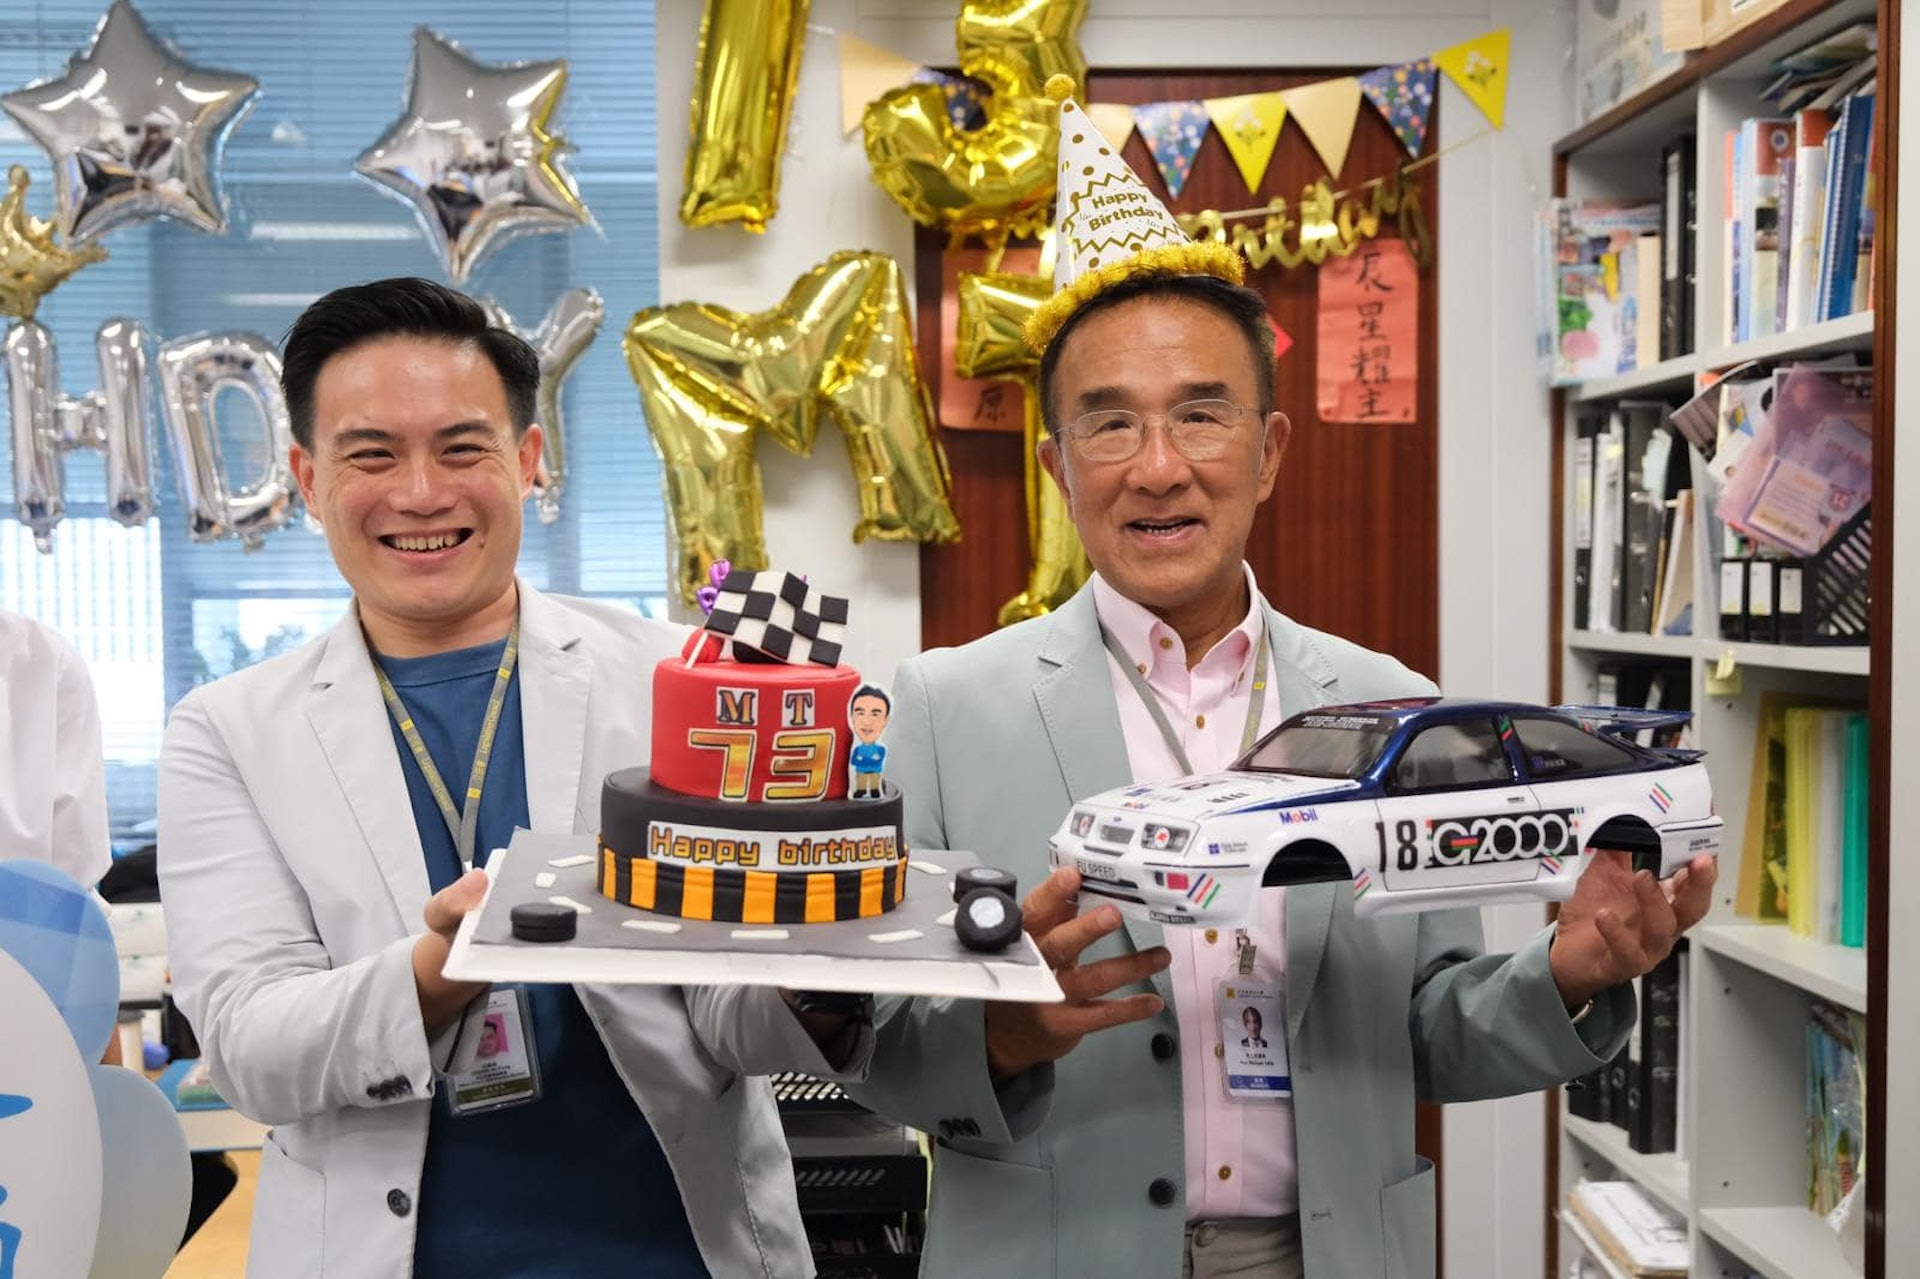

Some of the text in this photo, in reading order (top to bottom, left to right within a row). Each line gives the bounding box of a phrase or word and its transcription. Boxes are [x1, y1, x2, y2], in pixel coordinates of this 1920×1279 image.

[1088, 206, 1163, 231] Birthday
[1091, 192, 1147, 209] Happy
[3, 288, 603, 553] HDY
[689, 729, 834, 801] 73
[1278, 808, 1319, 824] Mobil
[650, 826, 897, 866] Happy birthday
[1375, 813, 1569, 873] 18 G2000
